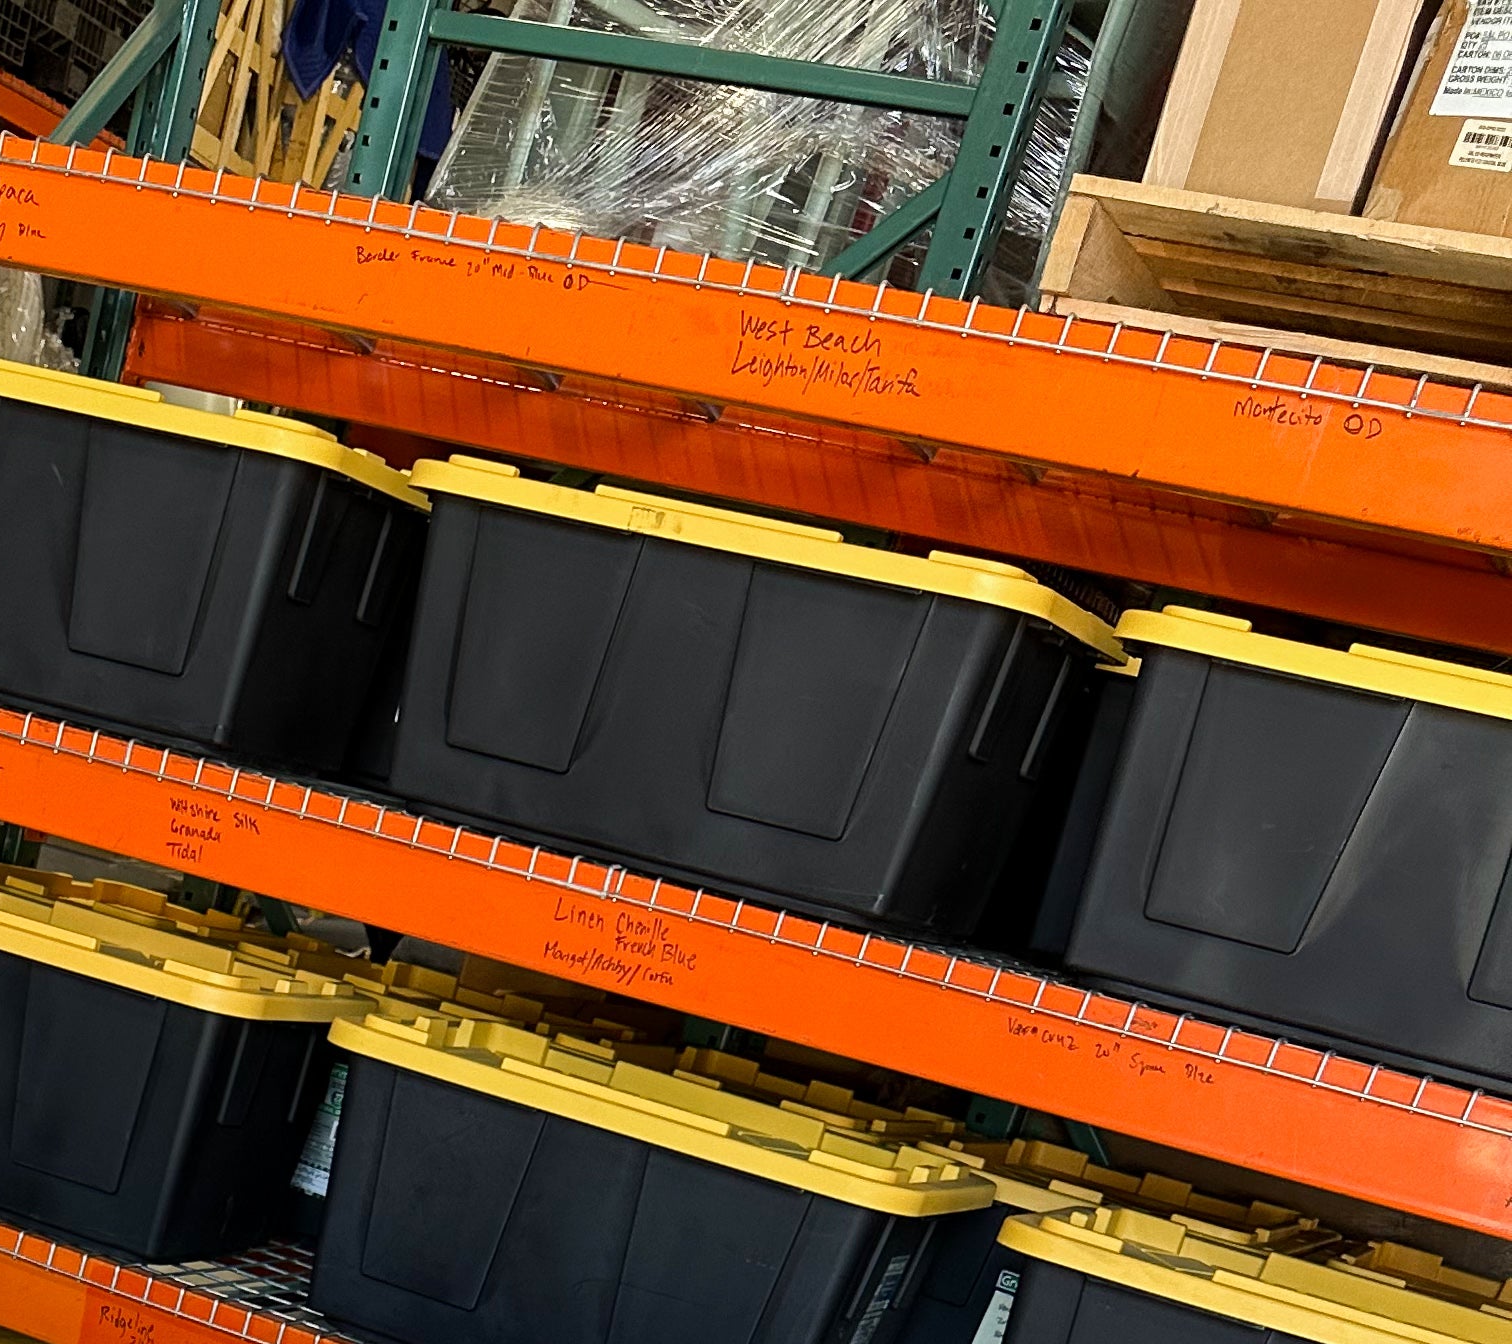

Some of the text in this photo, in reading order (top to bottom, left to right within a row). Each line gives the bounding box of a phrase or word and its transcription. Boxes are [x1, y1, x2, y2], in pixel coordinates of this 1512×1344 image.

[740, 309, 882, 357] West Beach
[1233, 395, 1323, 426] Montecito
[170, 818, 221, 842] Granada
[233, 811, 261, 836] Silk
[165, 842, 203, 862] Tidal
[554, 897, 604, 932] Linen
[615, 935, 697, 971] French Blue
[99, 1305, 155, 1338] Ridgeline
